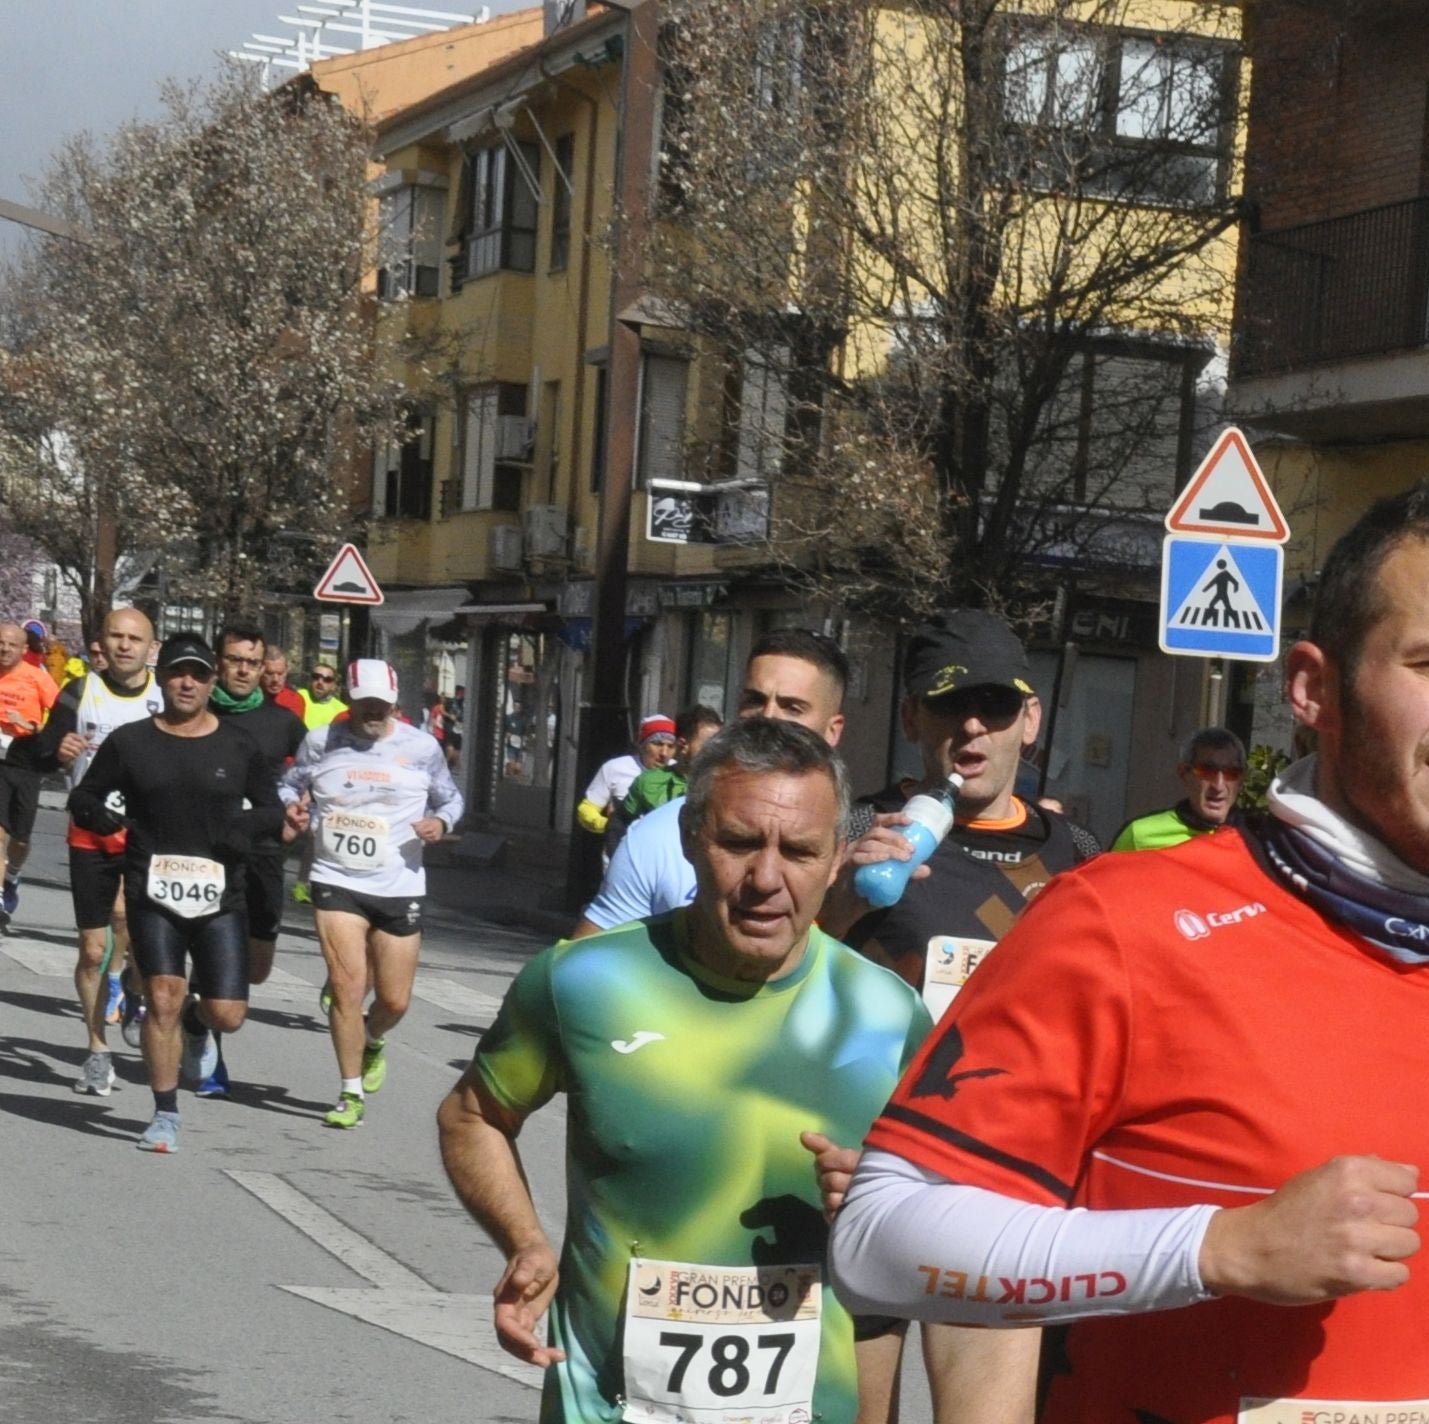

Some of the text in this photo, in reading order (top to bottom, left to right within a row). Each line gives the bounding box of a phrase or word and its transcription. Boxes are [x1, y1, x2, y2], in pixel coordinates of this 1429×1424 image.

[332, 832, 377, 858] 760
[153, 880, 219, 903] 3046
[678, 1271, 719, 1285] GRAN
[917, 1264, 1128, 1305] CLICKTEL
[675, 1281, 789, 1310] FONDO
[659, 1331, 796, 1397] 787
